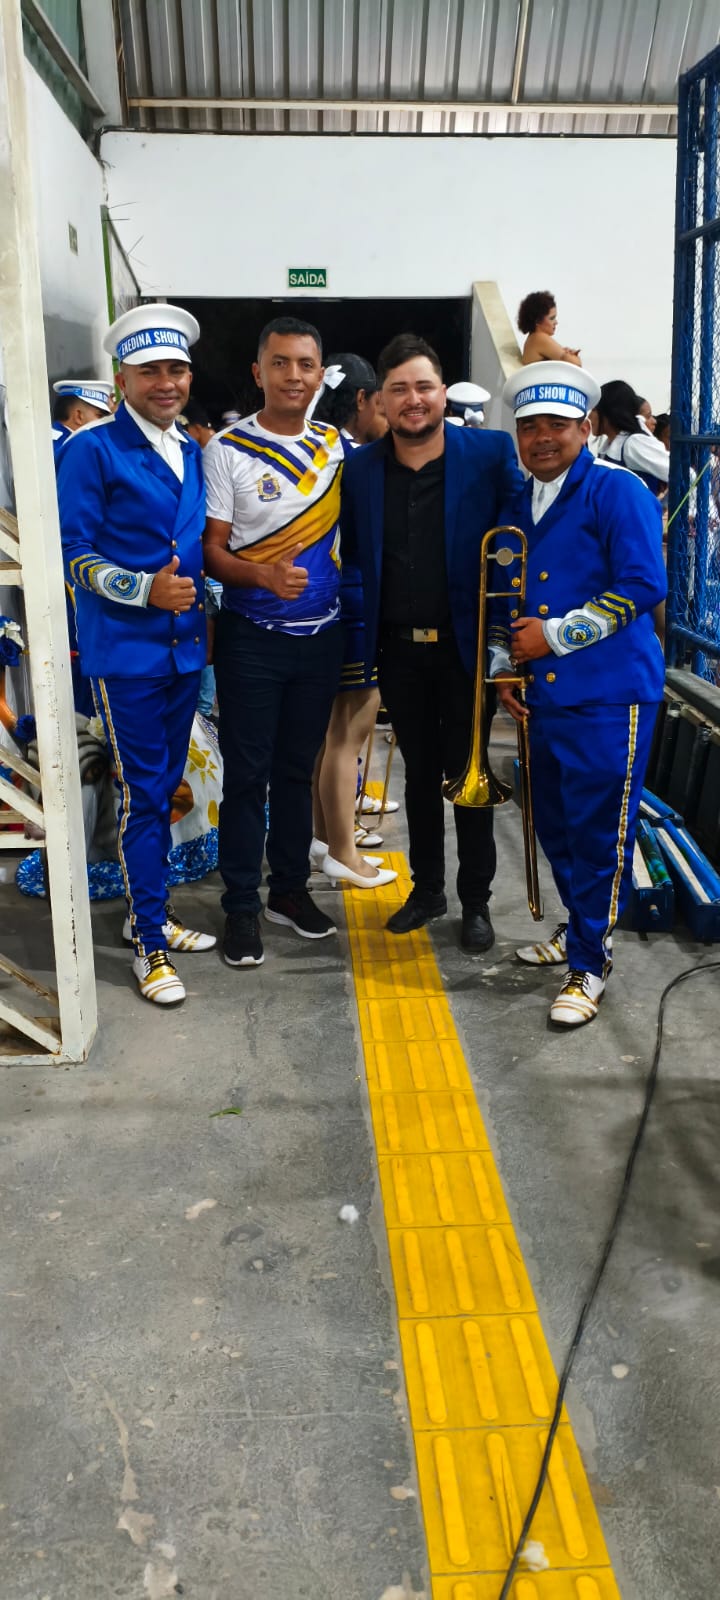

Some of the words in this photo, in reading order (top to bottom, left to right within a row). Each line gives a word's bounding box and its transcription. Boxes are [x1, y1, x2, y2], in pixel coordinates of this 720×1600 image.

[289, 272, 325, 285] SAÍDA
[153, 331, 179, 345] SHOW
[538, 386, 566, 400] SHOW
